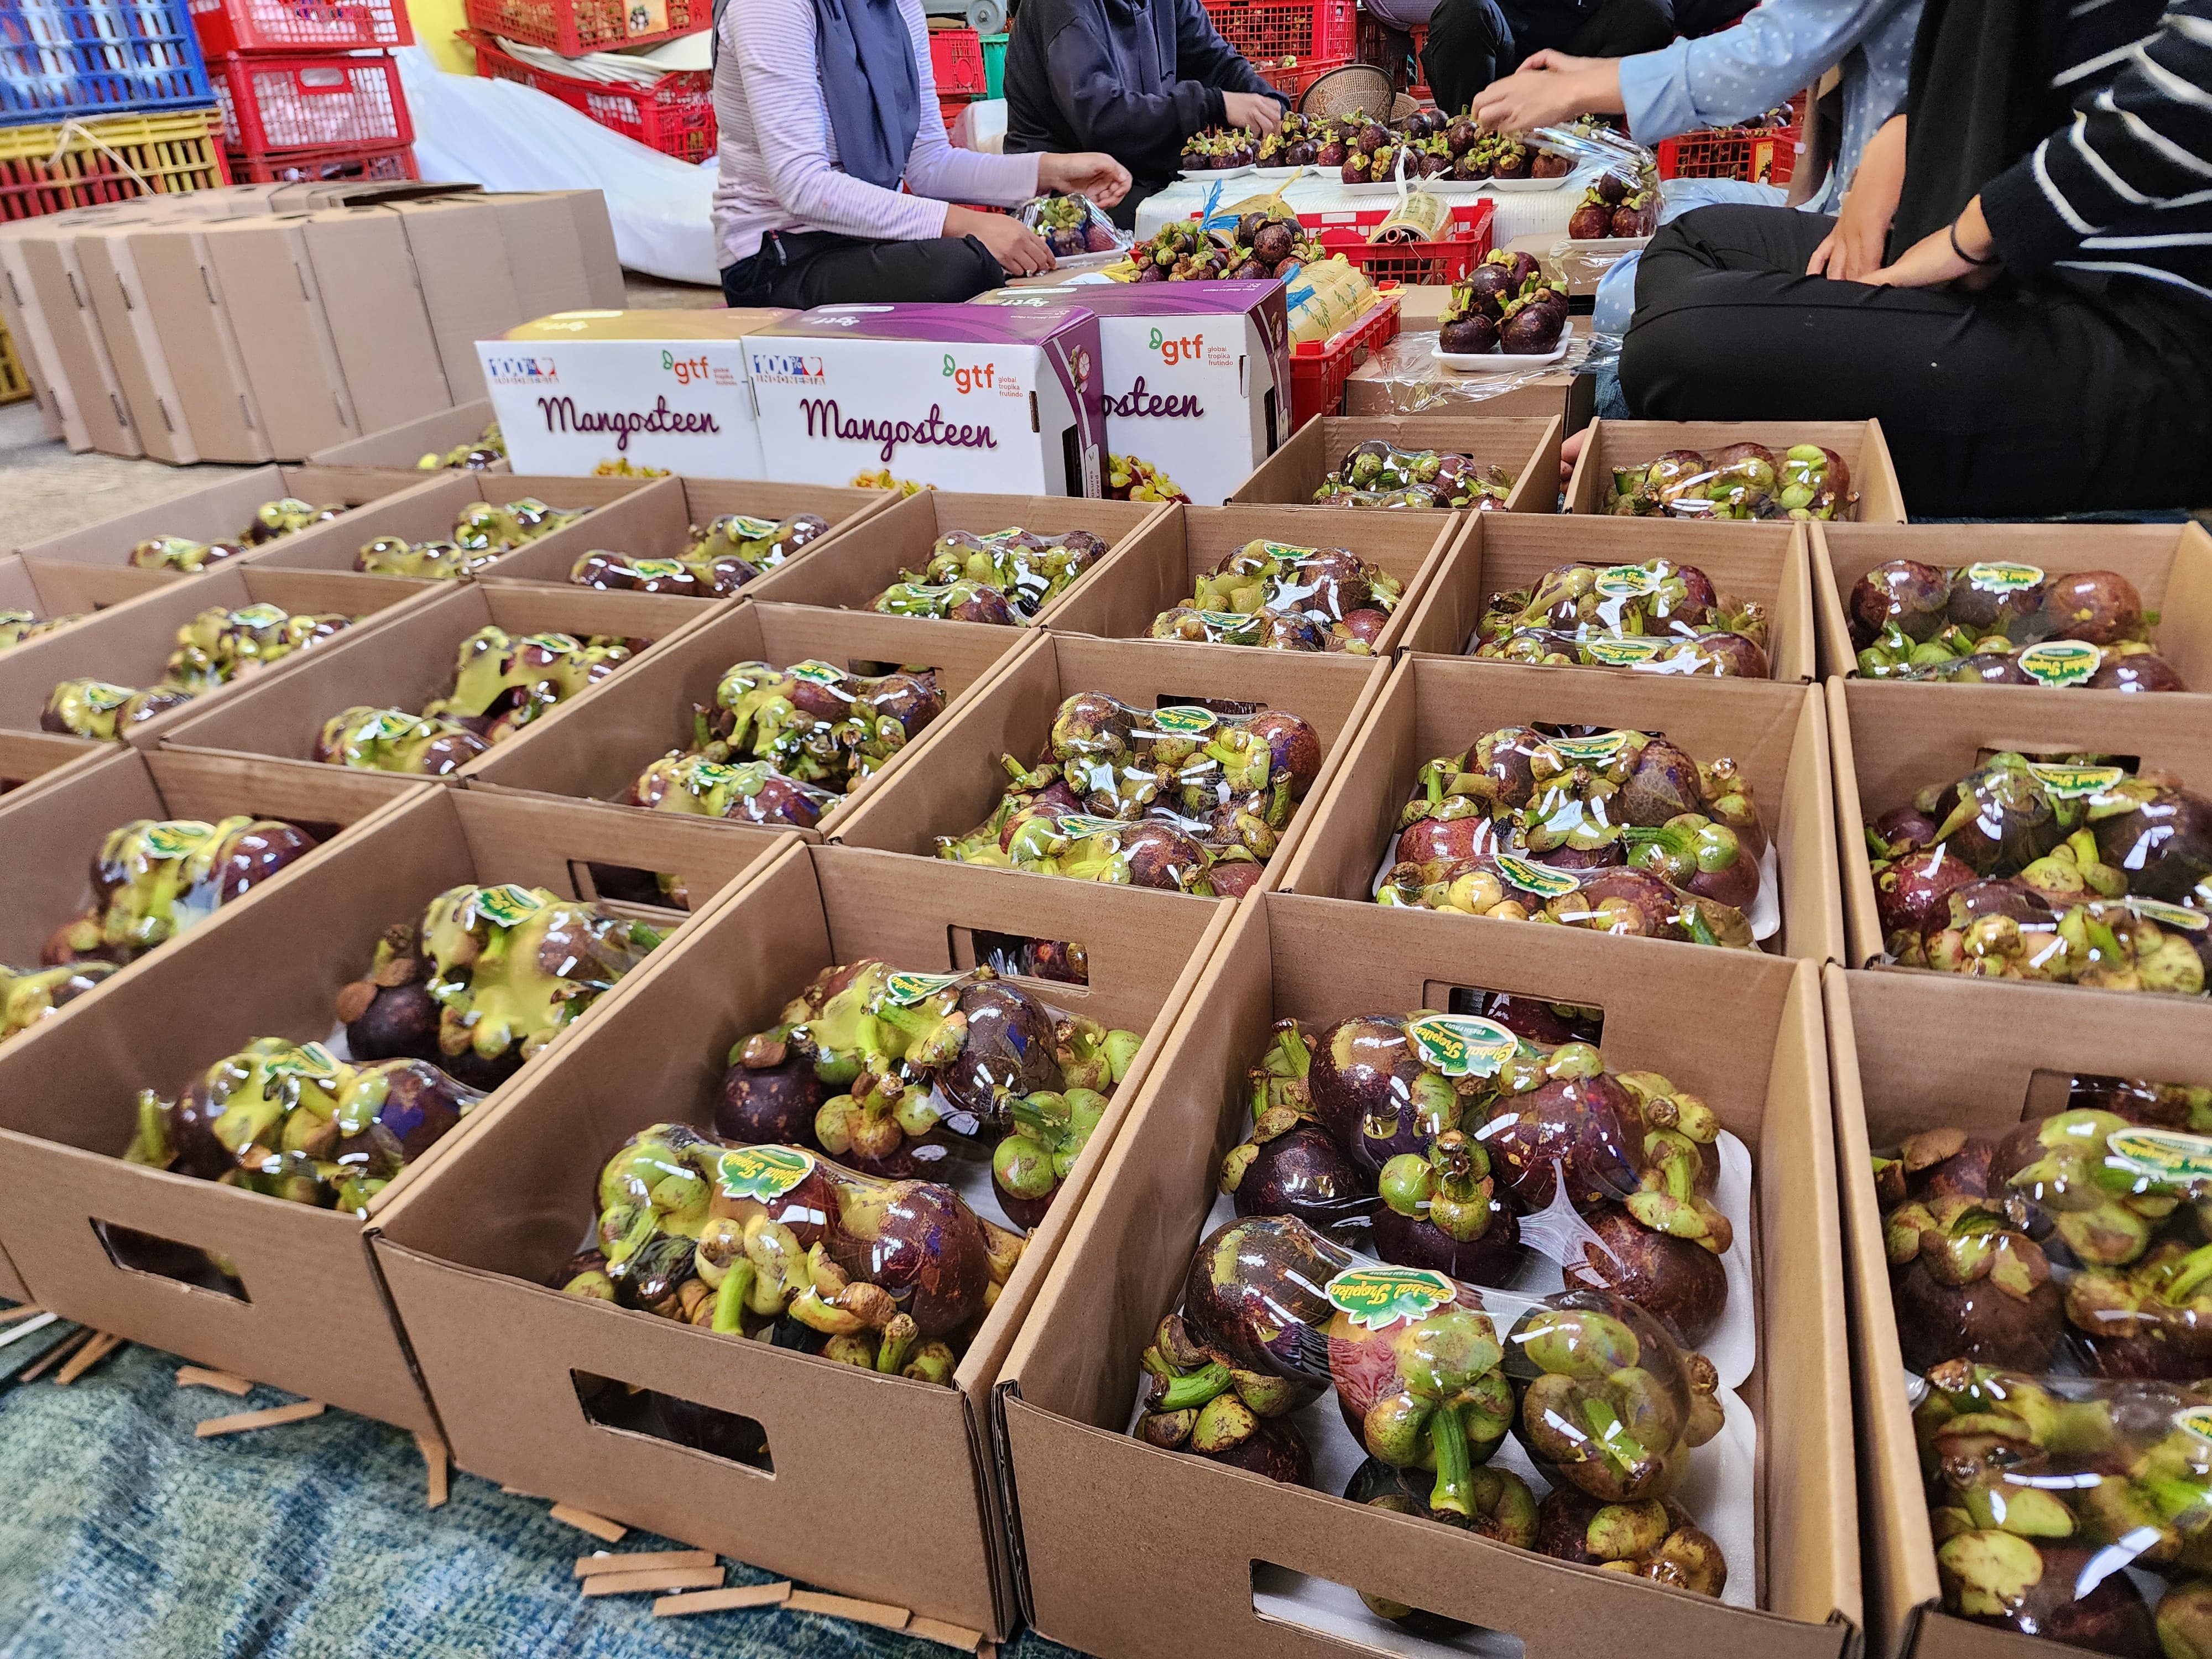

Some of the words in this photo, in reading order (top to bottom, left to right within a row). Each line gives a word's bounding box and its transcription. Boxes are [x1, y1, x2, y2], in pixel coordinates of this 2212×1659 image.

[1162, 333, 1204, 366] gtf
[674, 356, 709, 386] gtf
[757, 374, 826, 385] INDONESIA
[955, 363, 995, 394] gtf
[538, 395, 719, 451] Mangosteen
[800, 398, 997, 462] Mangosteen
[1444, 1022, 1463, 1032] FRUIT
[1462, 1026, 1486, 1036] FRESH
[1412, 1025, 1464, 1059] Tropika
[1464, 1041, 1514, 1062] Global
[724, 1153, 765, 1179] Tropika
[758, 1166, 809, 1188] Global
[1329, 1280, 1393, 1306] Tropika
[1393, 1283, 1453, 1300] Global
